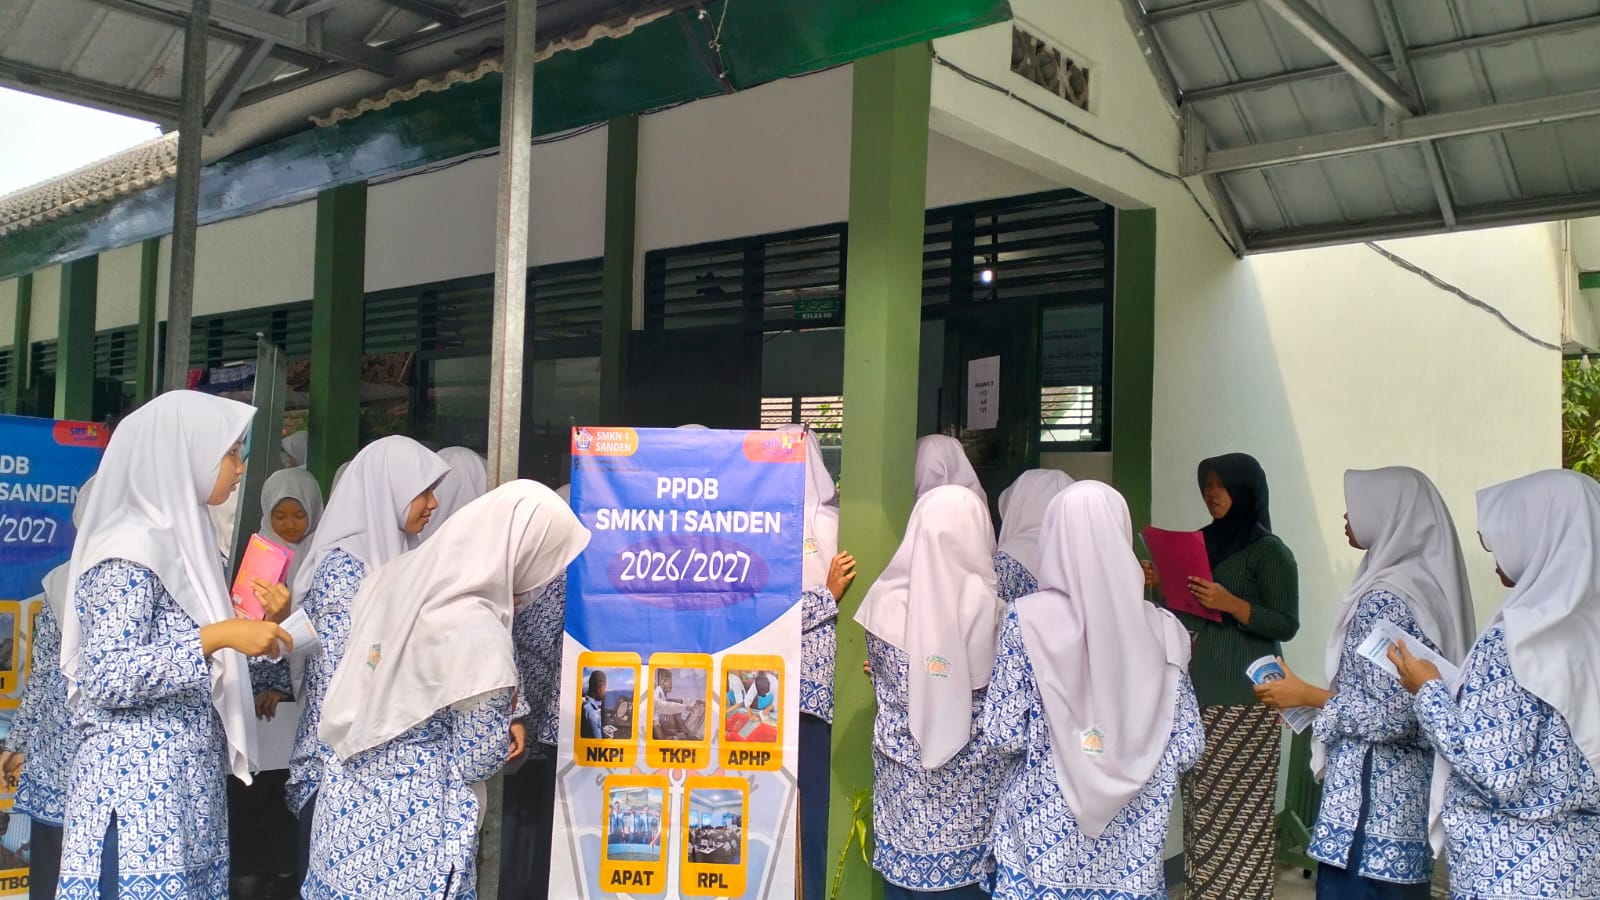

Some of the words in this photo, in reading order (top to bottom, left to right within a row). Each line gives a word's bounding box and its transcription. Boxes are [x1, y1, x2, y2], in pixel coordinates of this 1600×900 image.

[595, 431, 621, 442] SMKN
[595, 442, 631, 452] SANDEN
[656, 477, 719, 500] PPDB
[595, 508, 664, 531] SMKN
[669, 510, 678, 532] 1
[684, 510, 780, 533] SANDEN
[620, 548, 750, 583] 2026/2027
[586, 747, 624, 763] NKPI
[659, 748, 696, 763] TKPI
[728, 750, 771, 766] APHP
[611, 870, 654, 886] APAT
[697, 872, 728, 888] RPL
